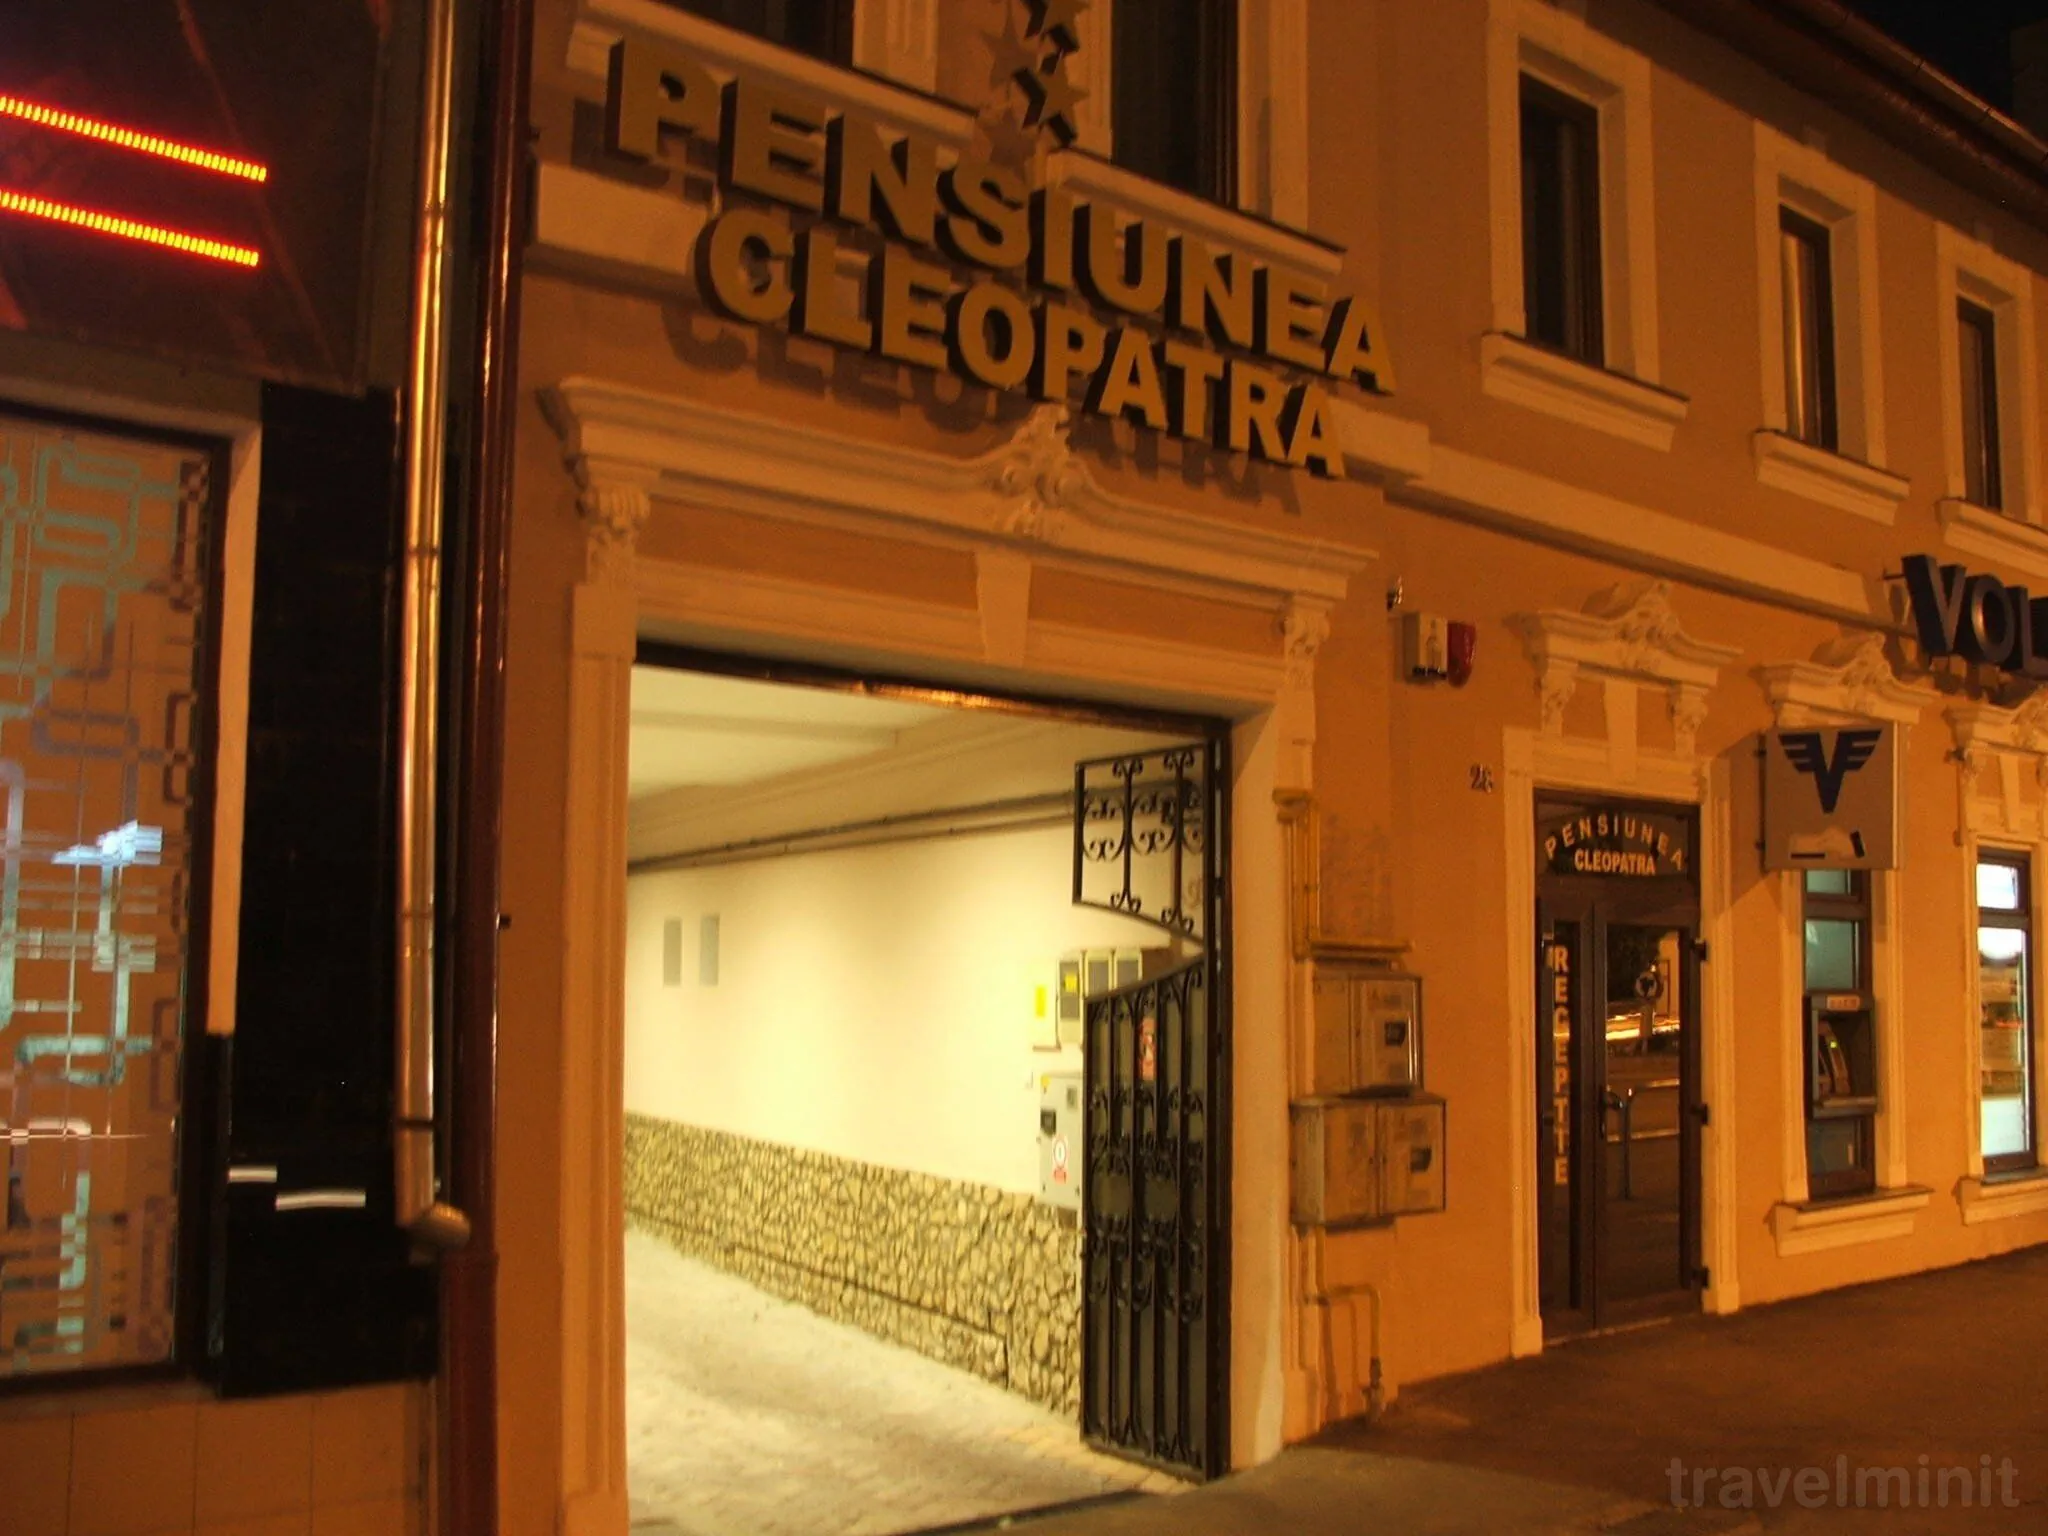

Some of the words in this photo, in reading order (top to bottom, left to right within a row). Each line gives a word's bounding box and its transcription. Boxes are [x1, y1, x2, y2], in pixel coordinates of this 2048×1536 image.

[609, 36, 1396, 394] PENSIUNEA
[696, 206, 1345, 478] CLEOPATRA
[1545, 813, 1683, 871] PENSIUNEA
[1574, 848, 1656, 876] CLEOPATRA
